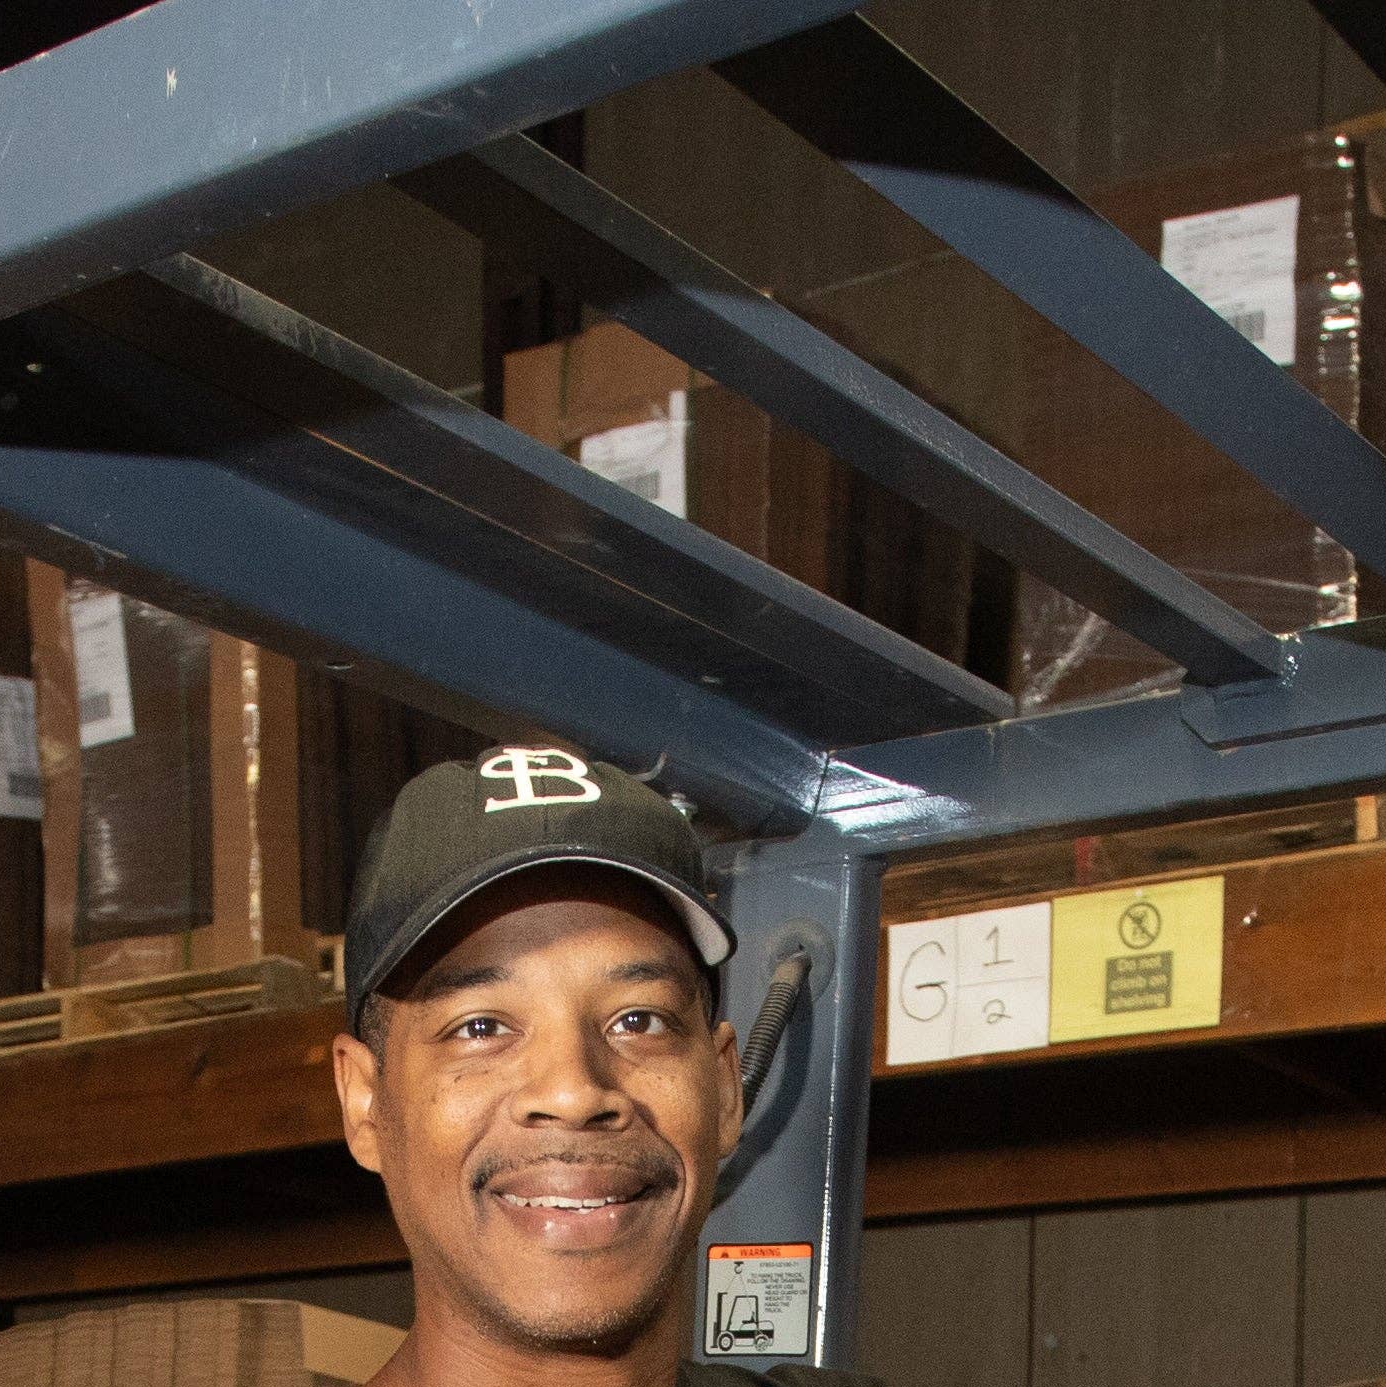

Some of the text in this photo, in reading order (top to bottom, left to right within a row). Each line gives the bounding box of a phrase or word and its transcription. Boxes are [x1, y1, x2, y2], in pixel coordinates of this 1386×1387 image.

[983, 926, 1014, 967] 1
[900, 940, 948, 1022] G
[983, 999, 1011, 1024] 2
[740, 1248, 781, 1257] WARNING
